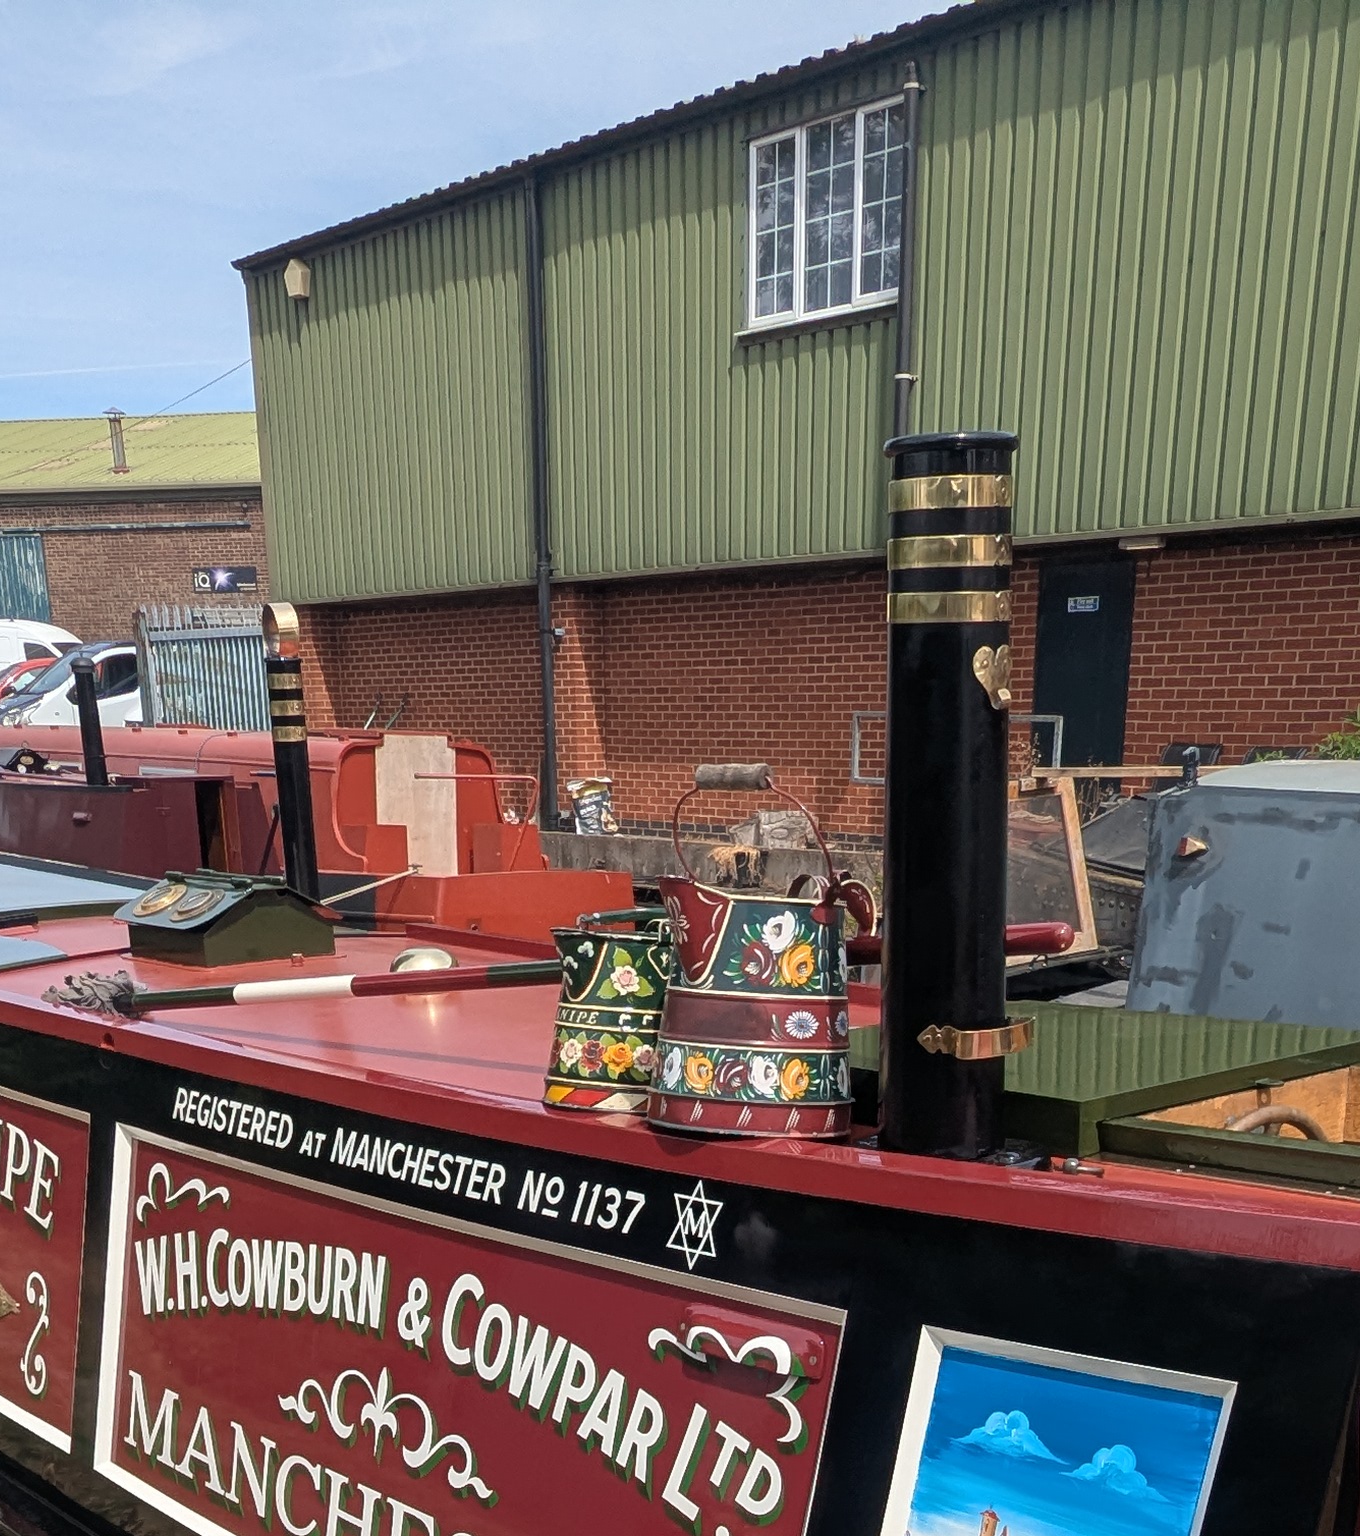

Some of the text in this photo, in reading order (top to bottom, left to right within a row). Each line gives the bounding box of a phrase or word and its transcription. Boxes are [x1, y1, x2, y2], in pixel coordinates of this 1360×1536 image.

[557, 1007, 599, 1025] NIPE
[172, 1086, 294, 1150] REGISTERED
[299, 1129, 327, 1159] AT
[329, 1127, 507, 1205] MANCHESTER
[570, 1180, 647, 1235] 1137
[396, 1276, 432, 1349] &
[441, 1272, 665, 1484] COWPAR
